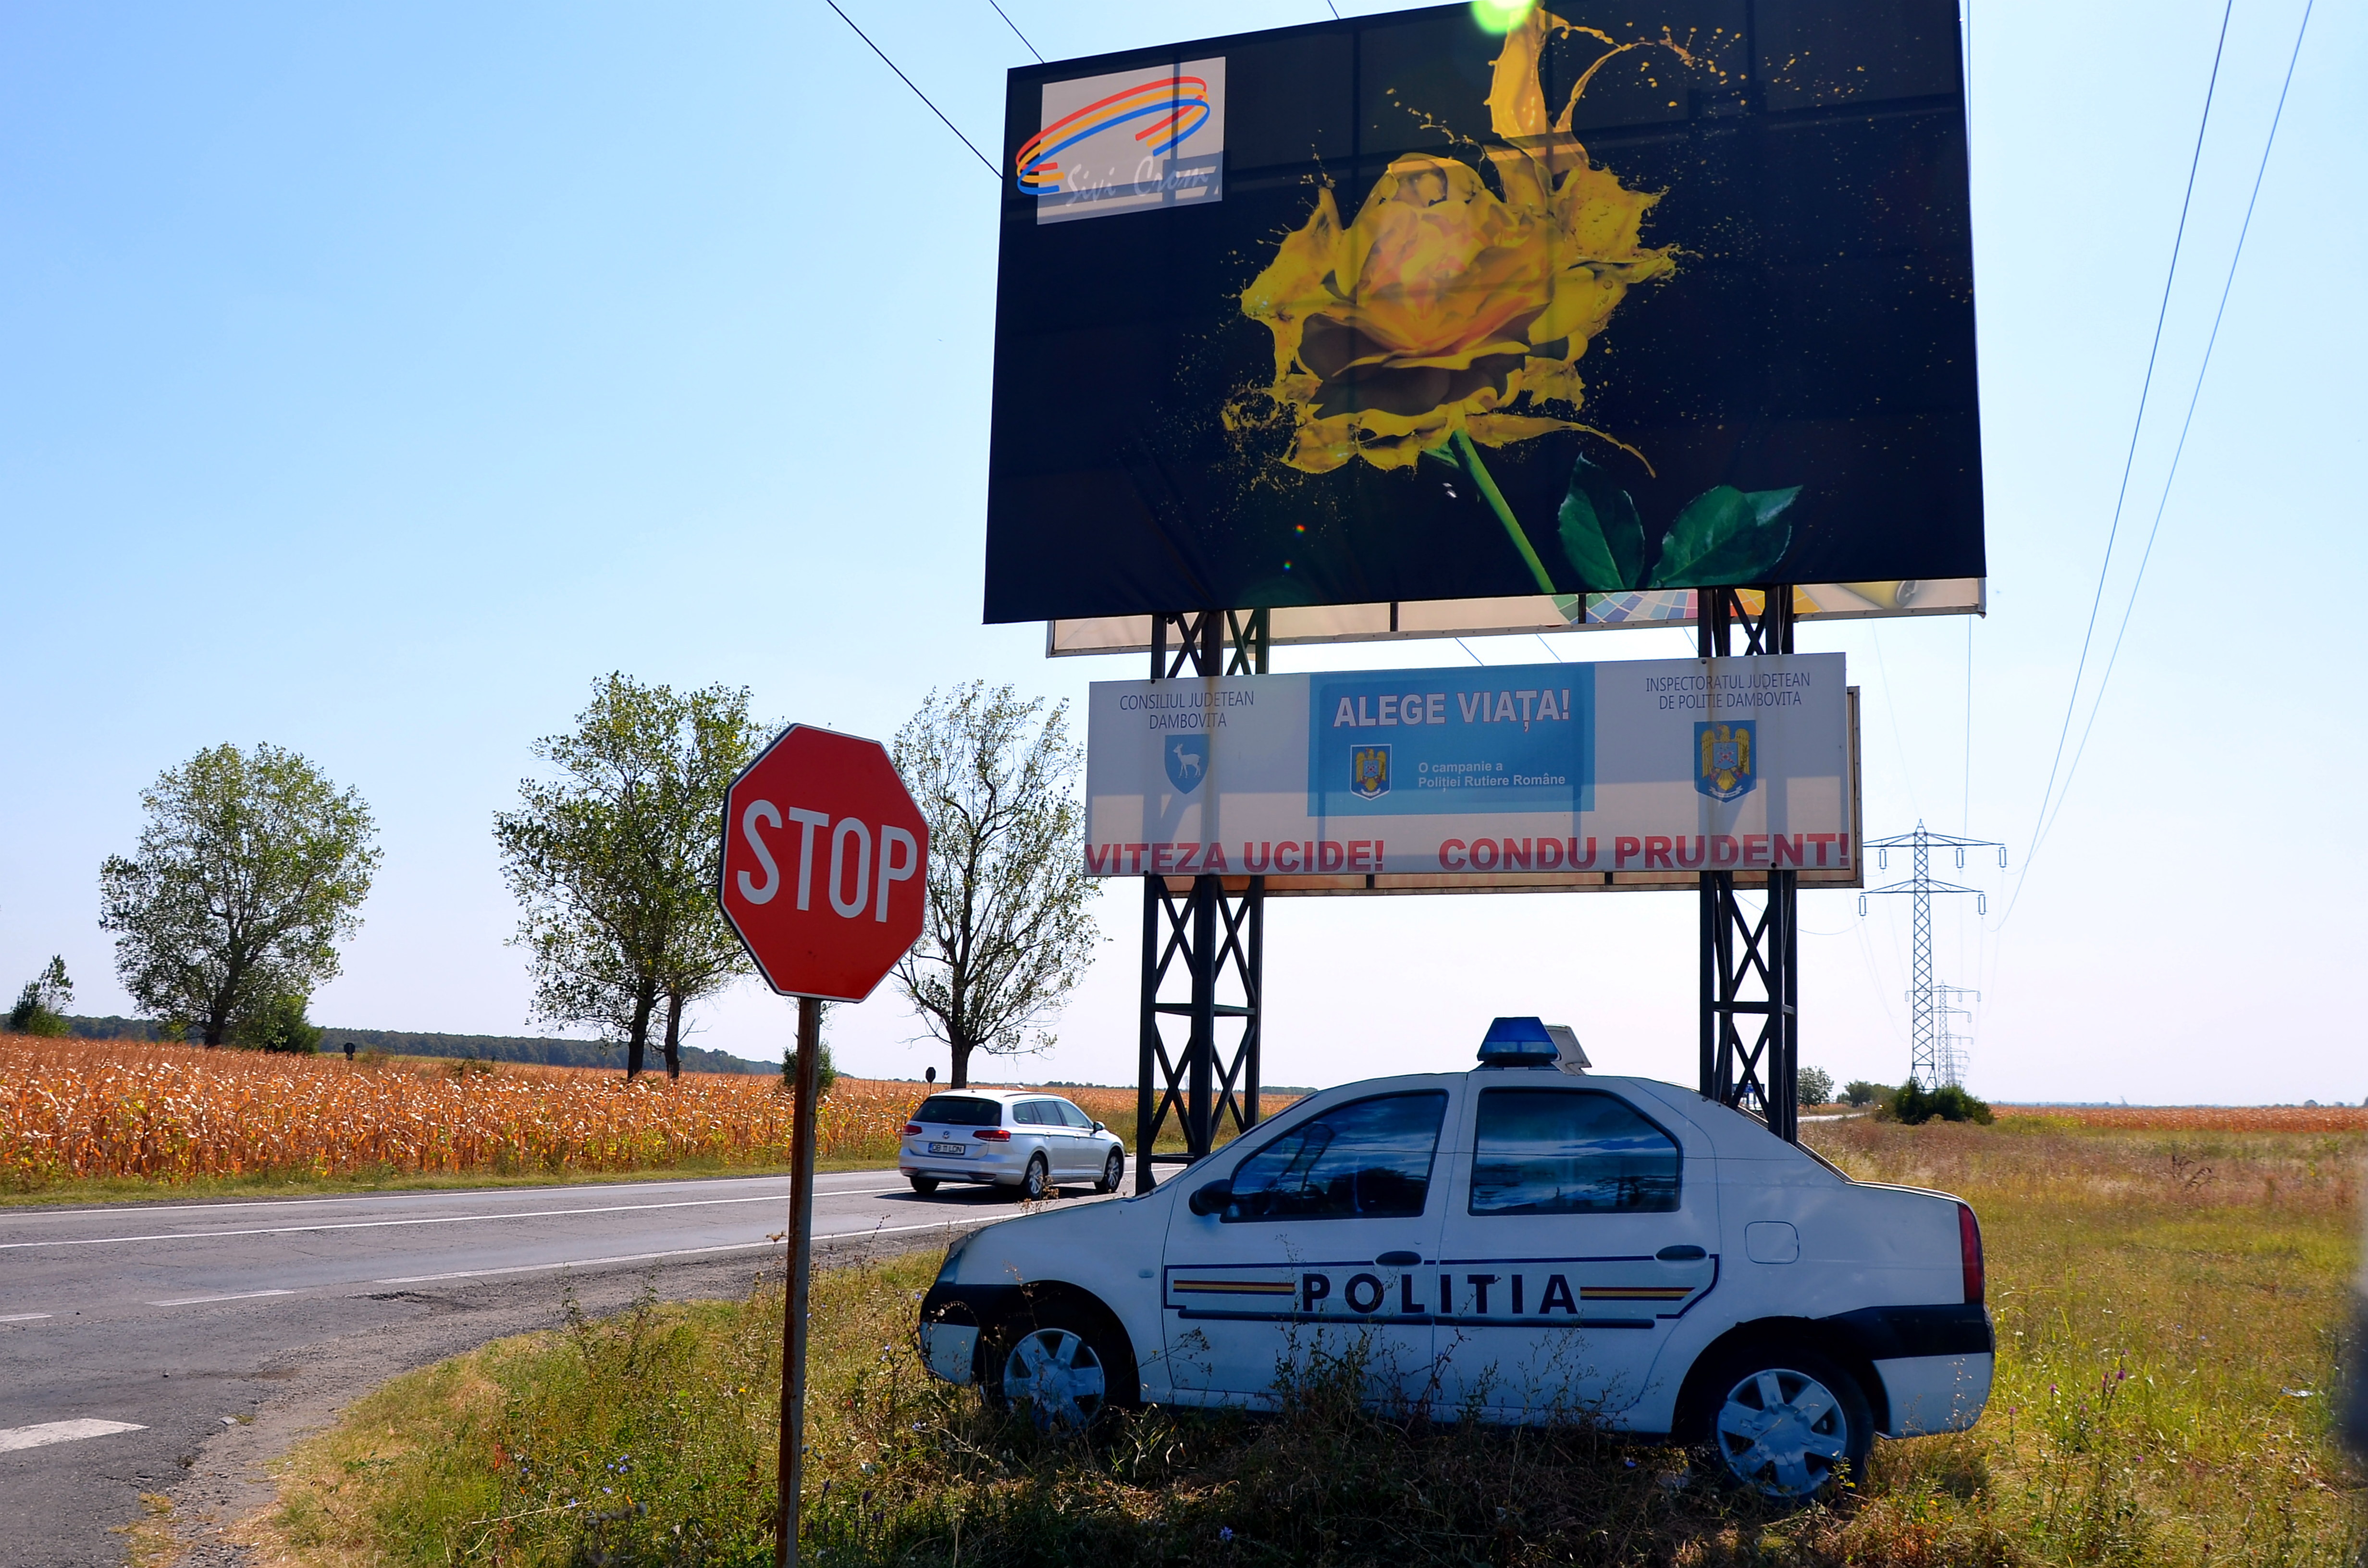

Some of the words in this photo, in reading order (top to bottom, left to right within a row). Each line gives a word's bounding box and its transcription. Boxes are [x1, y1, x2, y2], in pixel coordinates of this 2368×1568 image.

[1646, 675, 1744, 692] INSPECTORATUL
[1748, 673, 1810, 689] JUDETEAN
[1120, 693, 1185, 710] CONSILIUL
[1189, 691, 1254, 708] JUDETEAN
[1333, 693, 1446, 727] ALEGE
[1457, 688, 1570, 732] VIAȚA!
[1659, 695, 1674, 710] DE
[1679, 694, 1722, 709] POLITIE
[1727, 691, 1802, 708] DAMBOVITA
[1149, 712, 1227, 729] DAMBOVITA
[1418, 762, 1428, 772] O
[1432, 761, 1492, 774] campanie
[1496, 762, 1503, 771] a
[1418, 776, 1460, 792] Poliției
[1465, 775, 1509, 786] Rutiere
[1514, 772, 1565, 785] Române
[737, 799, 918, 923] STOP
[1085, 842, 1229, 874] VITEZA
[1244, 840, 1384, 872] UCIDE!
[1438, 837, 1596, 871] CONDU
[1615, 833, 1849, 869] PRUDENT!
[1302, 1273, 1578, 1314] POLITIA
